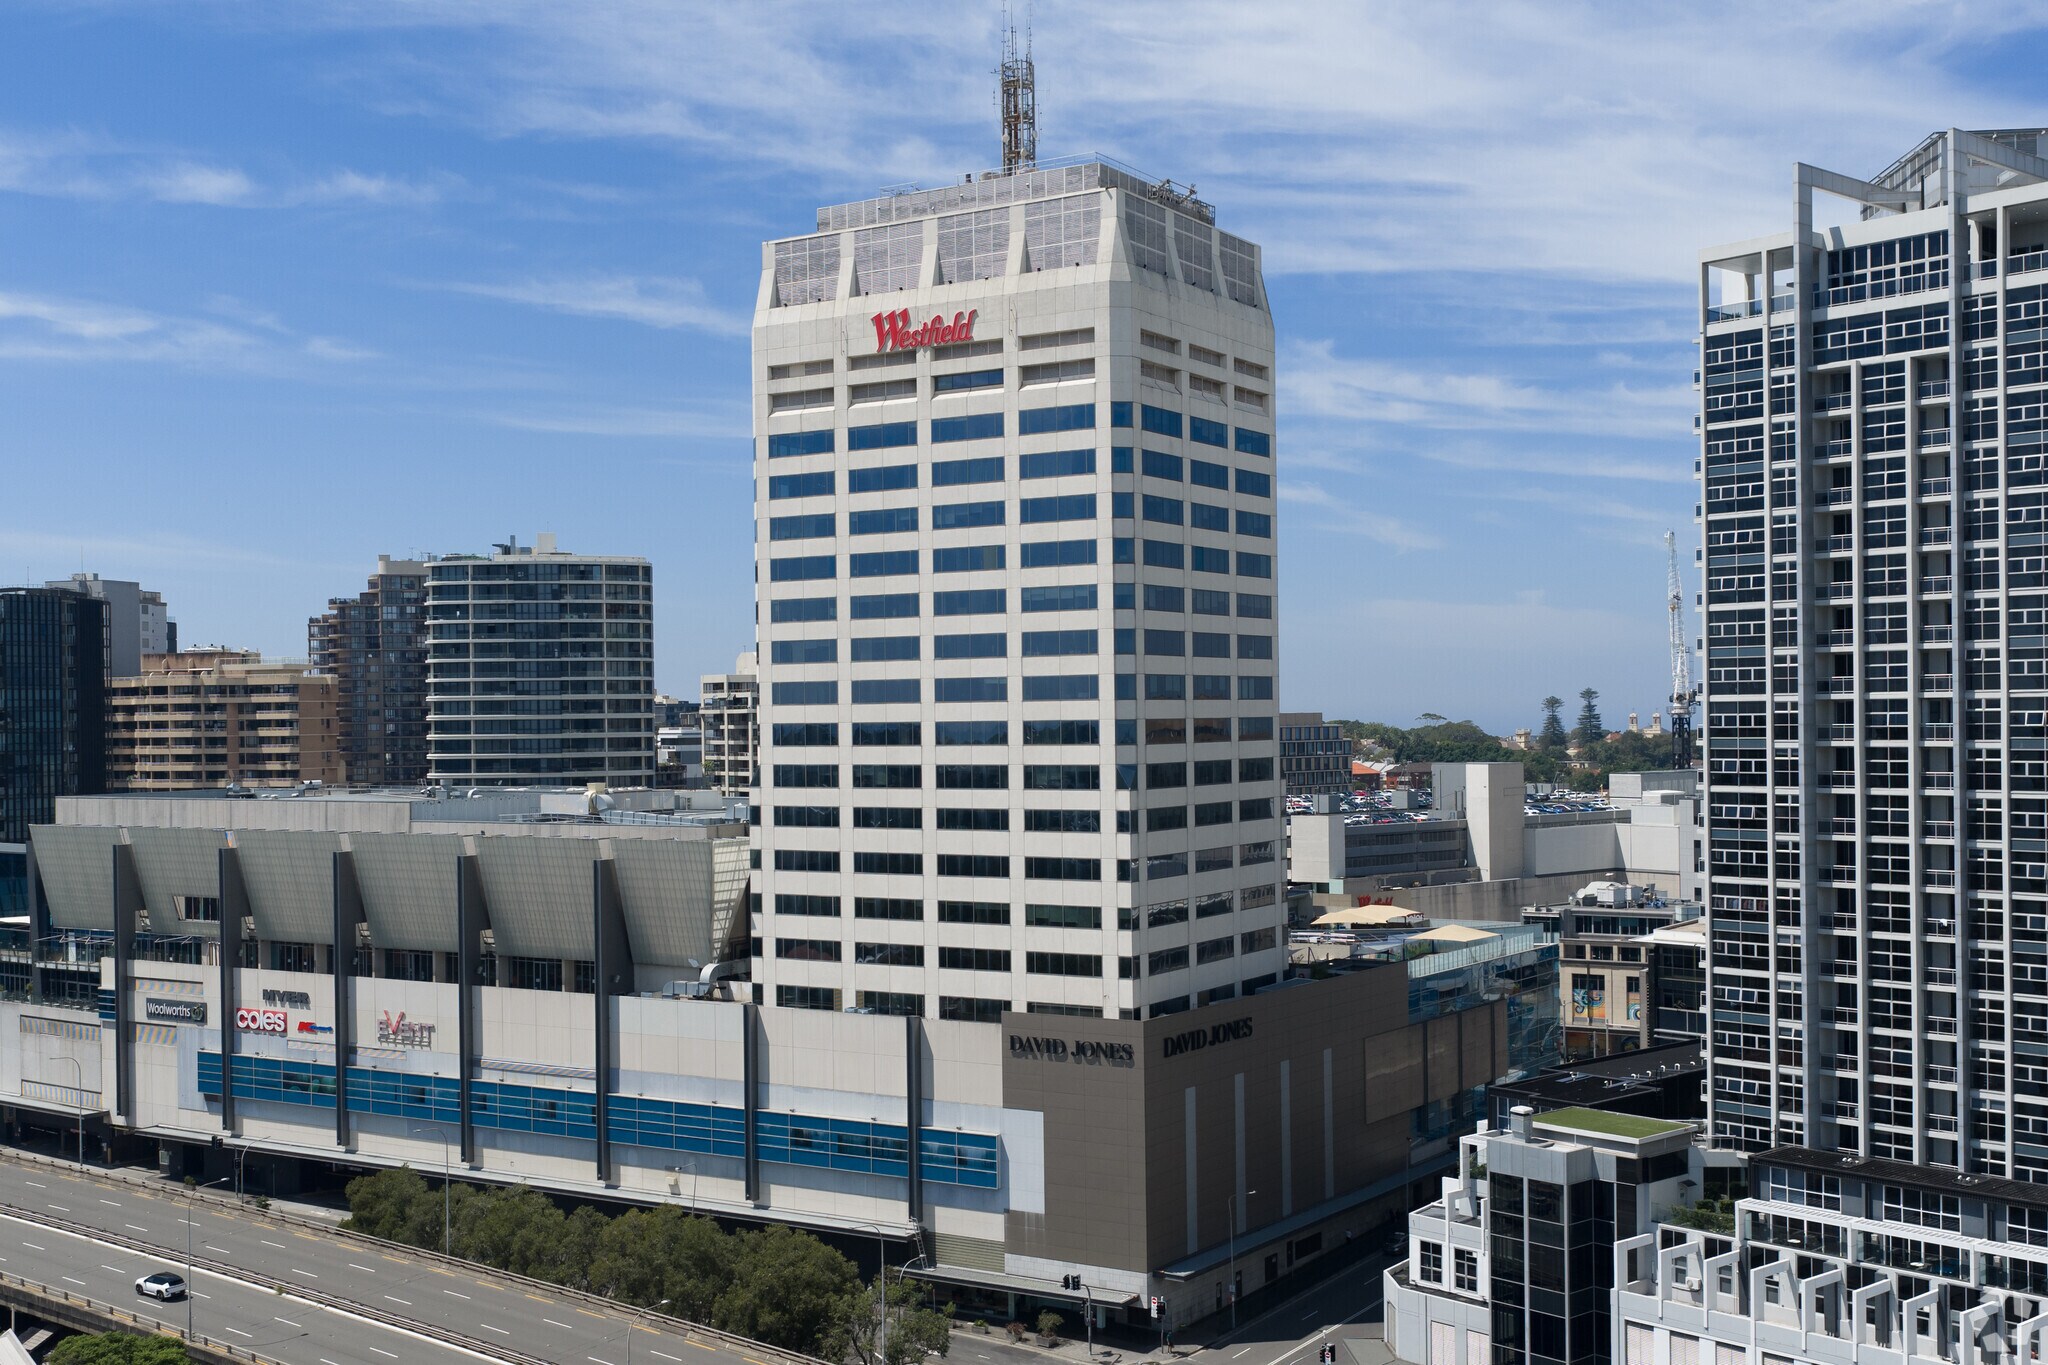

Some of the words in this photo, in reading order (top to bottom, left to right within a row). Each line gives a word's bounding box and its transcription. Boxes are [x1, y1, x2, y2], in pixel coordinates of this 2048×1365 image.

[871, 308, 977, 353] Westfield
[263, 989, 310, 1004] MYER
[147, 1002, 191, 1017] Woolworths
[237, 1010, 285, 1032] coles
[377, 1009, 435, 1039] EVENT
[1009, 1035, 1067, 1055] DAVID
[1071, 1040, 1133, 1060] JONES
[1163, 1029, 1207, 1058] DAVID
[1208, 1017, 1253, 1046] JONES
